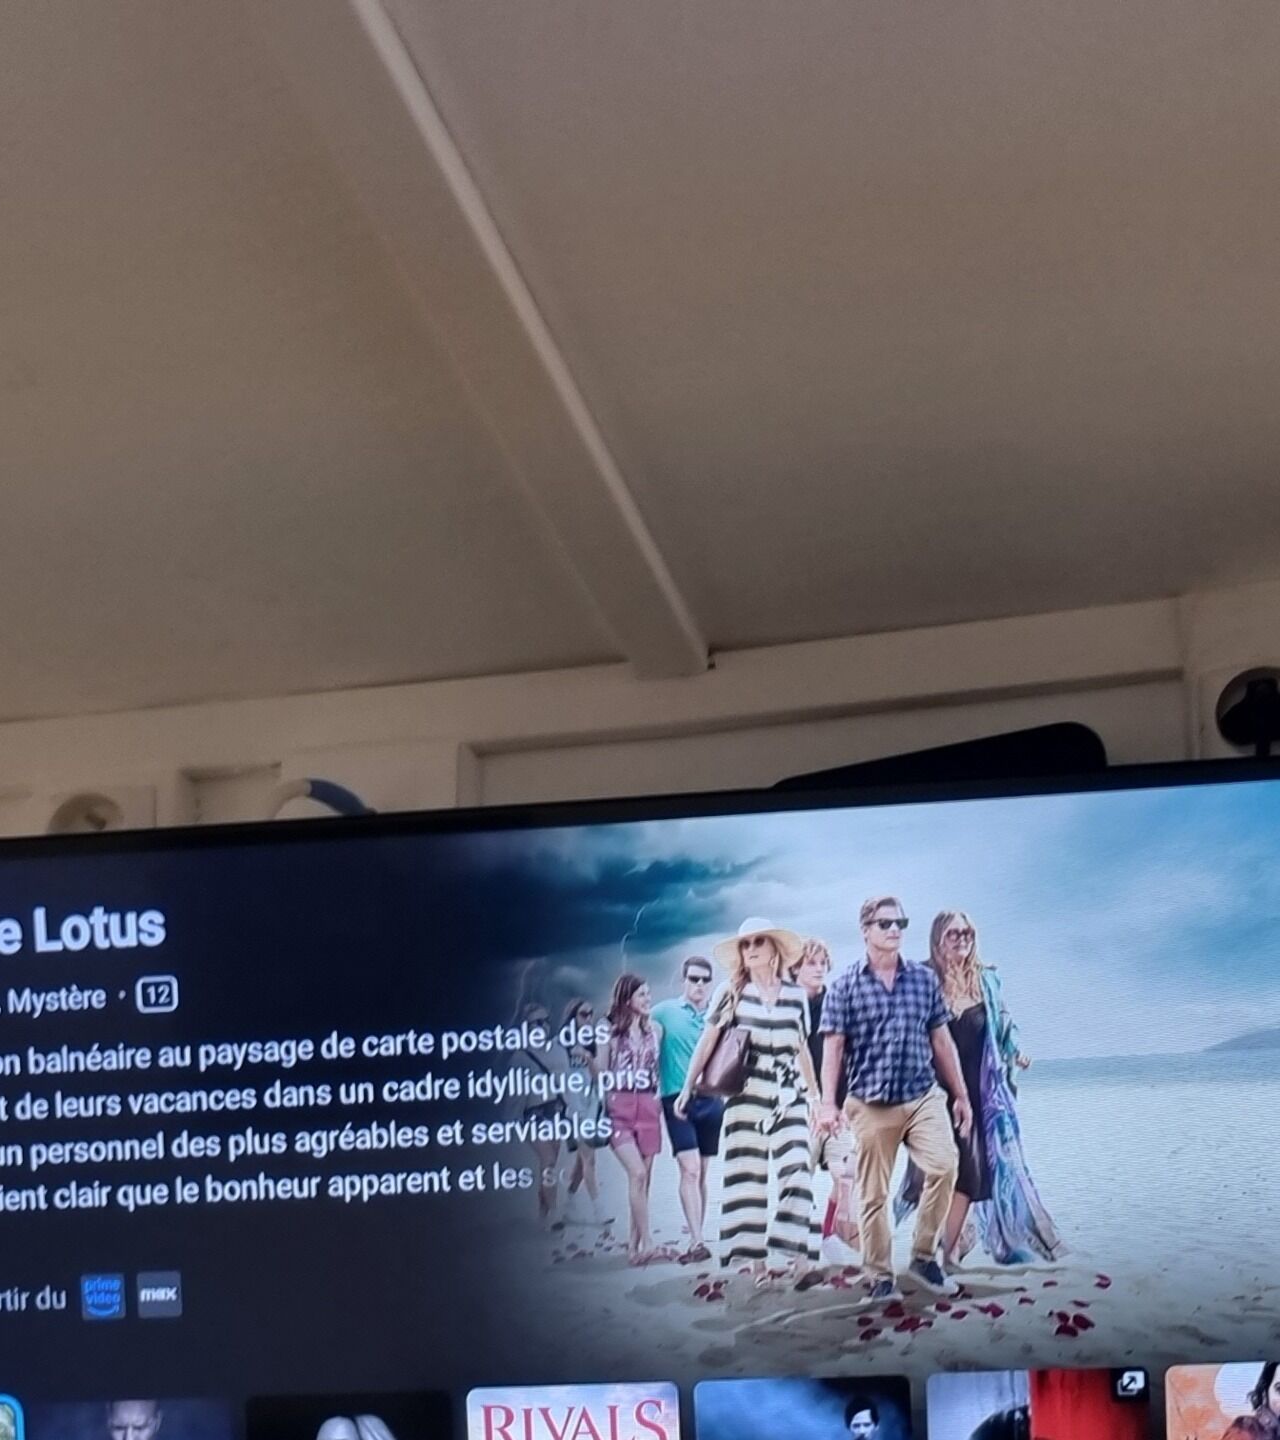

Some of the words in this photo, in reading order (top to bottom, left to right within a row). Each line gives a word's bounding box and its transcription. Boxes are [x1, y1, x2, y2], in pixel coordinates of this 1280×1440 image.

[32, 906, 166, 953] Lotus
[7, 983, 106, 1019] Mystère
[146, 984, 170, 1004] 12
[28, 1042, 152, 1075] balnéaire
[158, 1044, 192, 1068] au
[198, 1038, 314, 1073] paysage
[320, 1029, 356, 1060] de
[362, 1029, 435, 1056] carte
[441, 1022, 552, 1059] postale,
[558, 1017, 610, 1047] des
[14, 1092, 49, 1121] de
[55, 1091, 121, 1119] leurs
[128, 1087, 257, 1115] vacances
[263, 1079, 333, 1109] dans
[339, 1080, 375, 1104] un
[382, 1073, 460, 1103] cadre
[468, 1067, 591, 1103] idyllique,
[597, 1065, 651, 1098] pris
[29, 1131, 164, 1171] personnel
[171, 1129, 221, 1159] des
[227, 1125, 288, 1163] plus
[294, 1116, 429, 1158] agréables
[437, 1118, 464, 1146] et
[471, 1112, 621, 1145] serviables.
[54, 1180, 111, 1210] clair
[118, 1185, 169, 1211] que
[175, 1175, 200, 1204] le
[205, 1171, 321, 1203] bonheur
[327, 1164, 450, 1203] apparent
[459, 1164, 486, 1191] et
[493, 1161, 533, 1190] les
[36, 1285, 67, 1310] du
[140, 1287, 178, 1303] max
